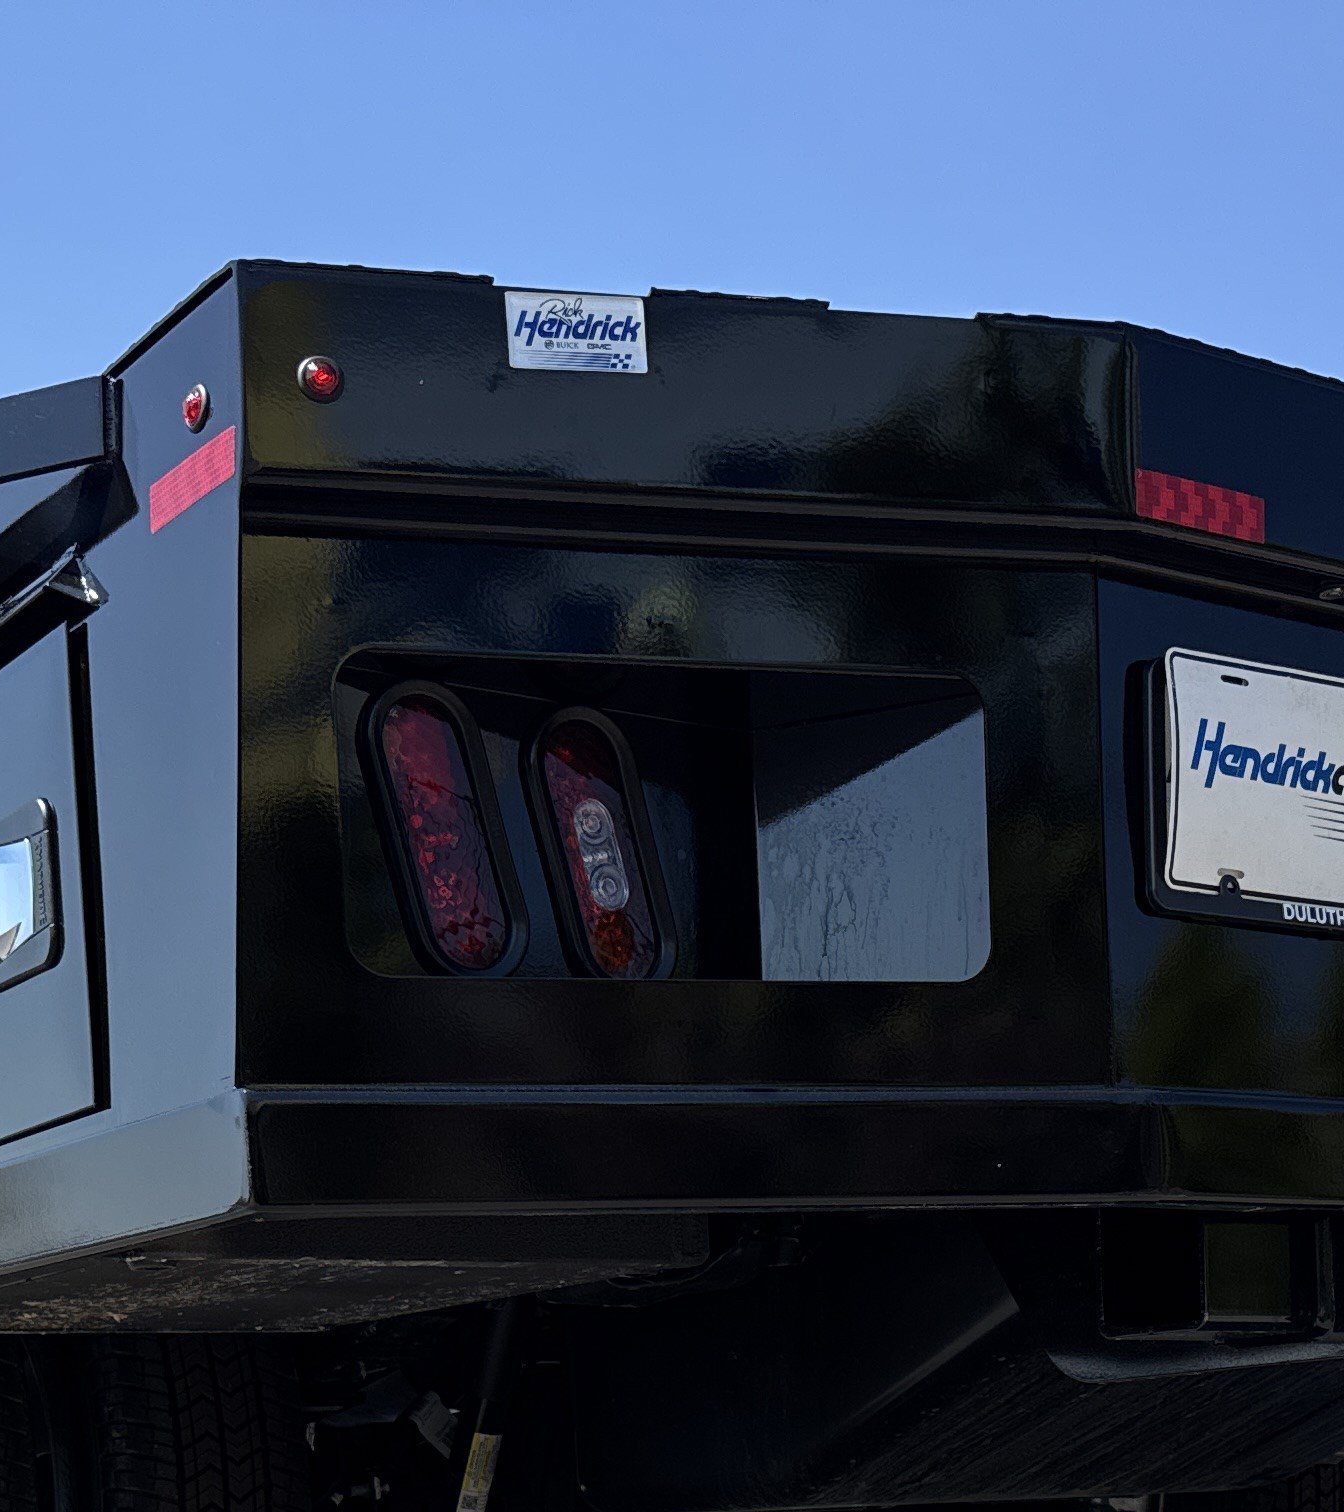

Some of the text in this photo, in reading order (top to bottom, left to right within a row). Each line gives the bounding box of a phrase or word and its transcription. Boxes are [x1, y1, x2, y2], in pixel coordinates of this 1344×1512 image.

[539, 297, 584, 323] Rick
[514, 310, 641, 346] Hendrick
[556, 341, 579, 349] BUICK
